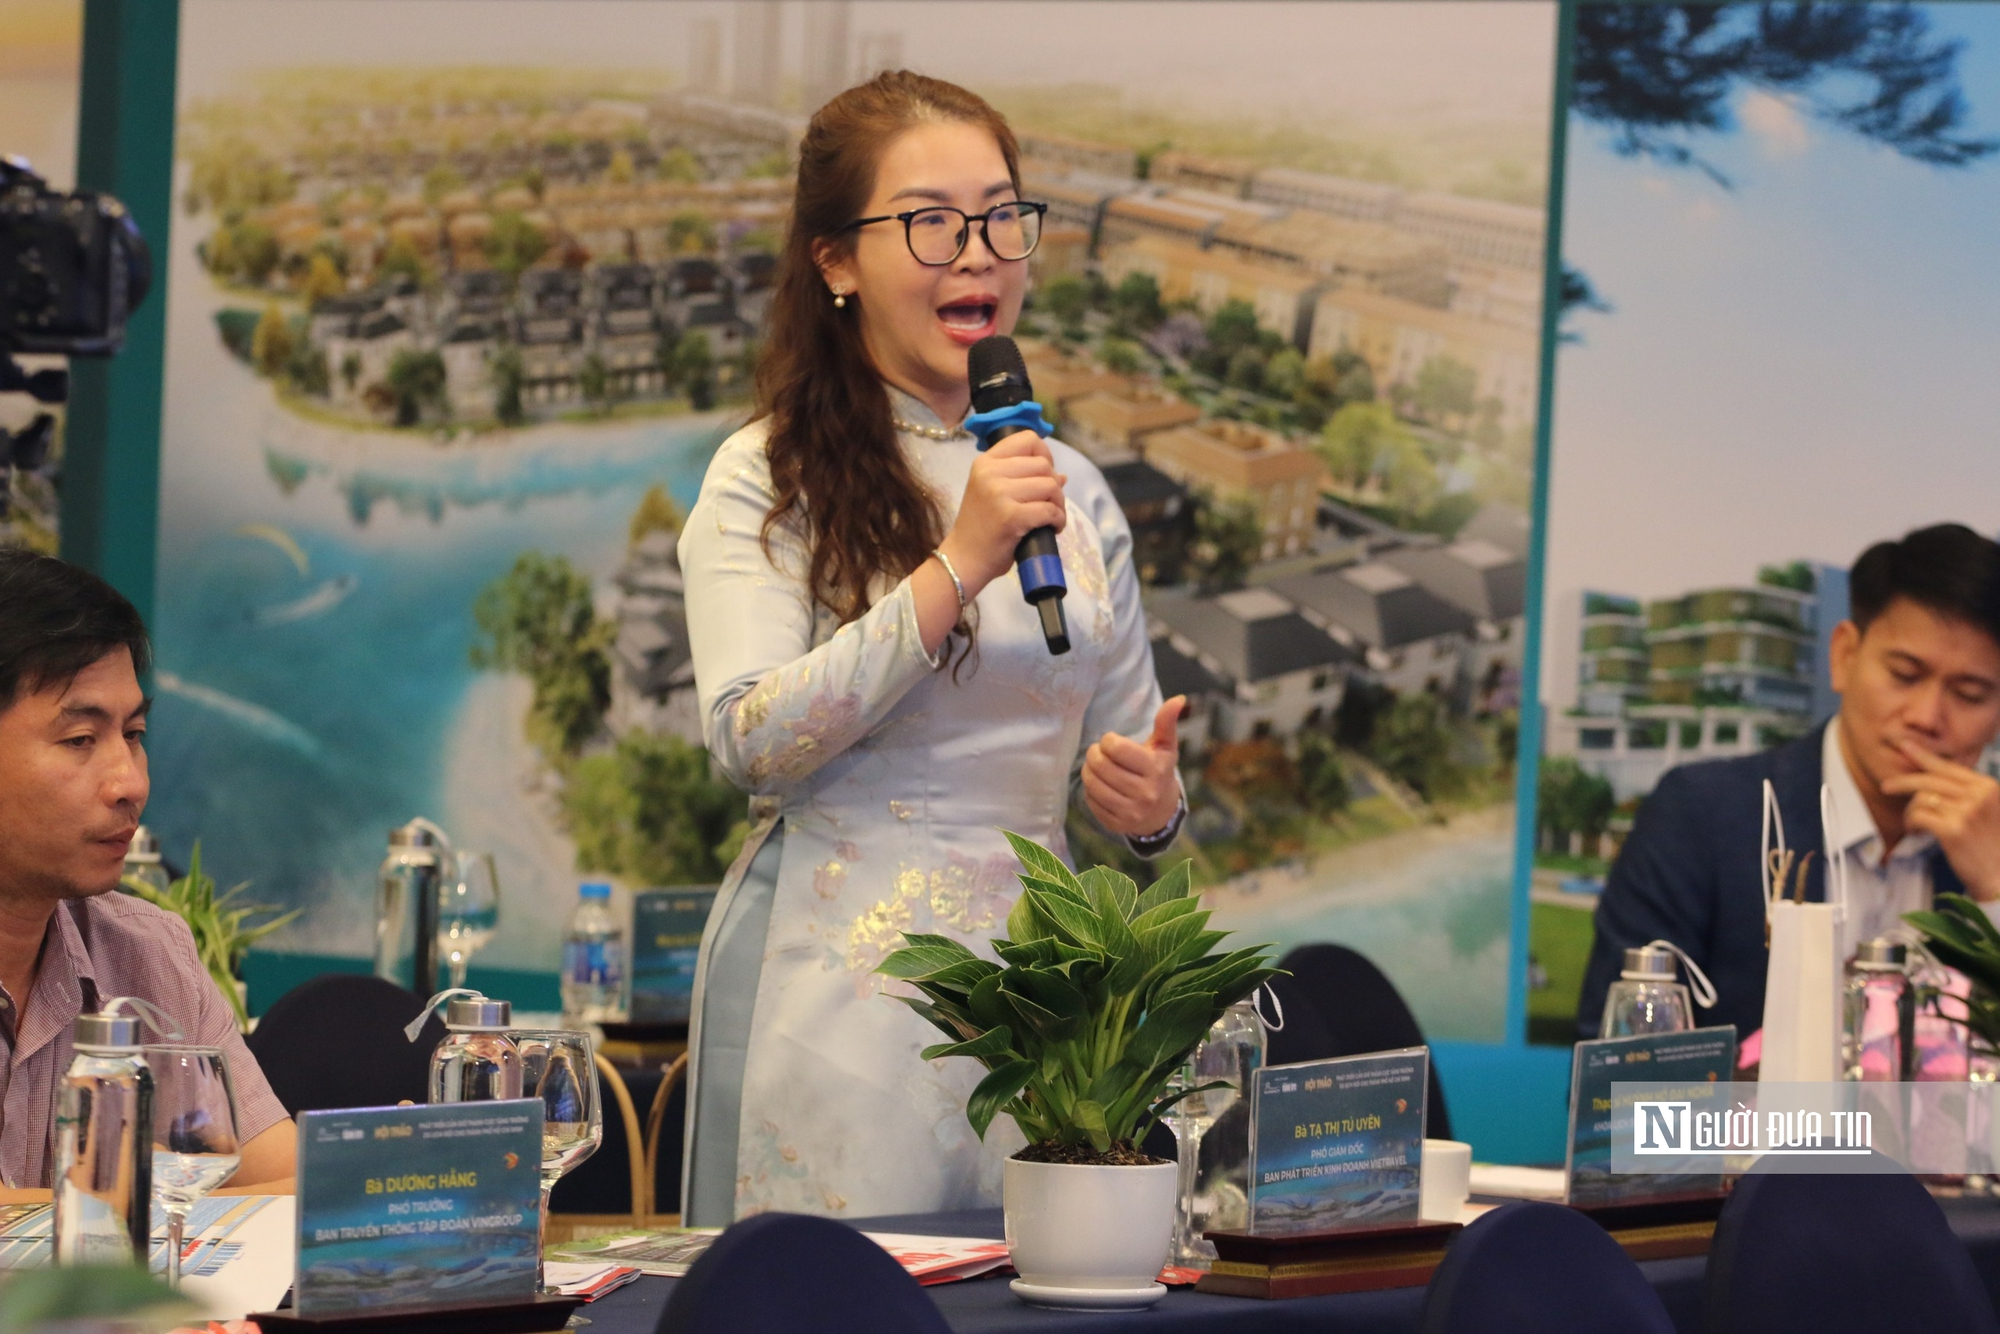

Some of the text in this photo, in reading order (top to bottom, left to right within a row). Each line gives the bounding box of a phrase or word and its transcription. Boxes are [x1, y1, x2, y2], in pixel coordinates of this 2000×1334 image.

[1295, 1123, 1307, 1139] Bà
[1309, 1123, 1322, 1139] TẠ
[1324, 1120, 1340, 1137] THỊ
[1355, 1113, 1381, 1131] UYÊN
[1311, 1140, 1364, 1159] PHÓ GIÁM ĐỐC
[1264, 1171, 1280, 1183] BAN
[1281, 1166, 1301, 1181] PHÁT
[1324, 1163, 1342, 1176] KINH
[1343, 1160, 1370, 1173] DOANH
[1370, 1155, 1407, 1170] VIETRAVEL
[365, 1178, 383, 1194] Bà
[386, 1174, 436, 1193] DƯƠNG
[388, 1200, 410, 1215] PHÓ
[315, 1228, 339, 1241] BAN
[381, 1219, 416, 1236] THÔNG
[439, 1214, 471, 1231] ĐOÀN
[470, 1214, 523, 1229] VINGROUP
